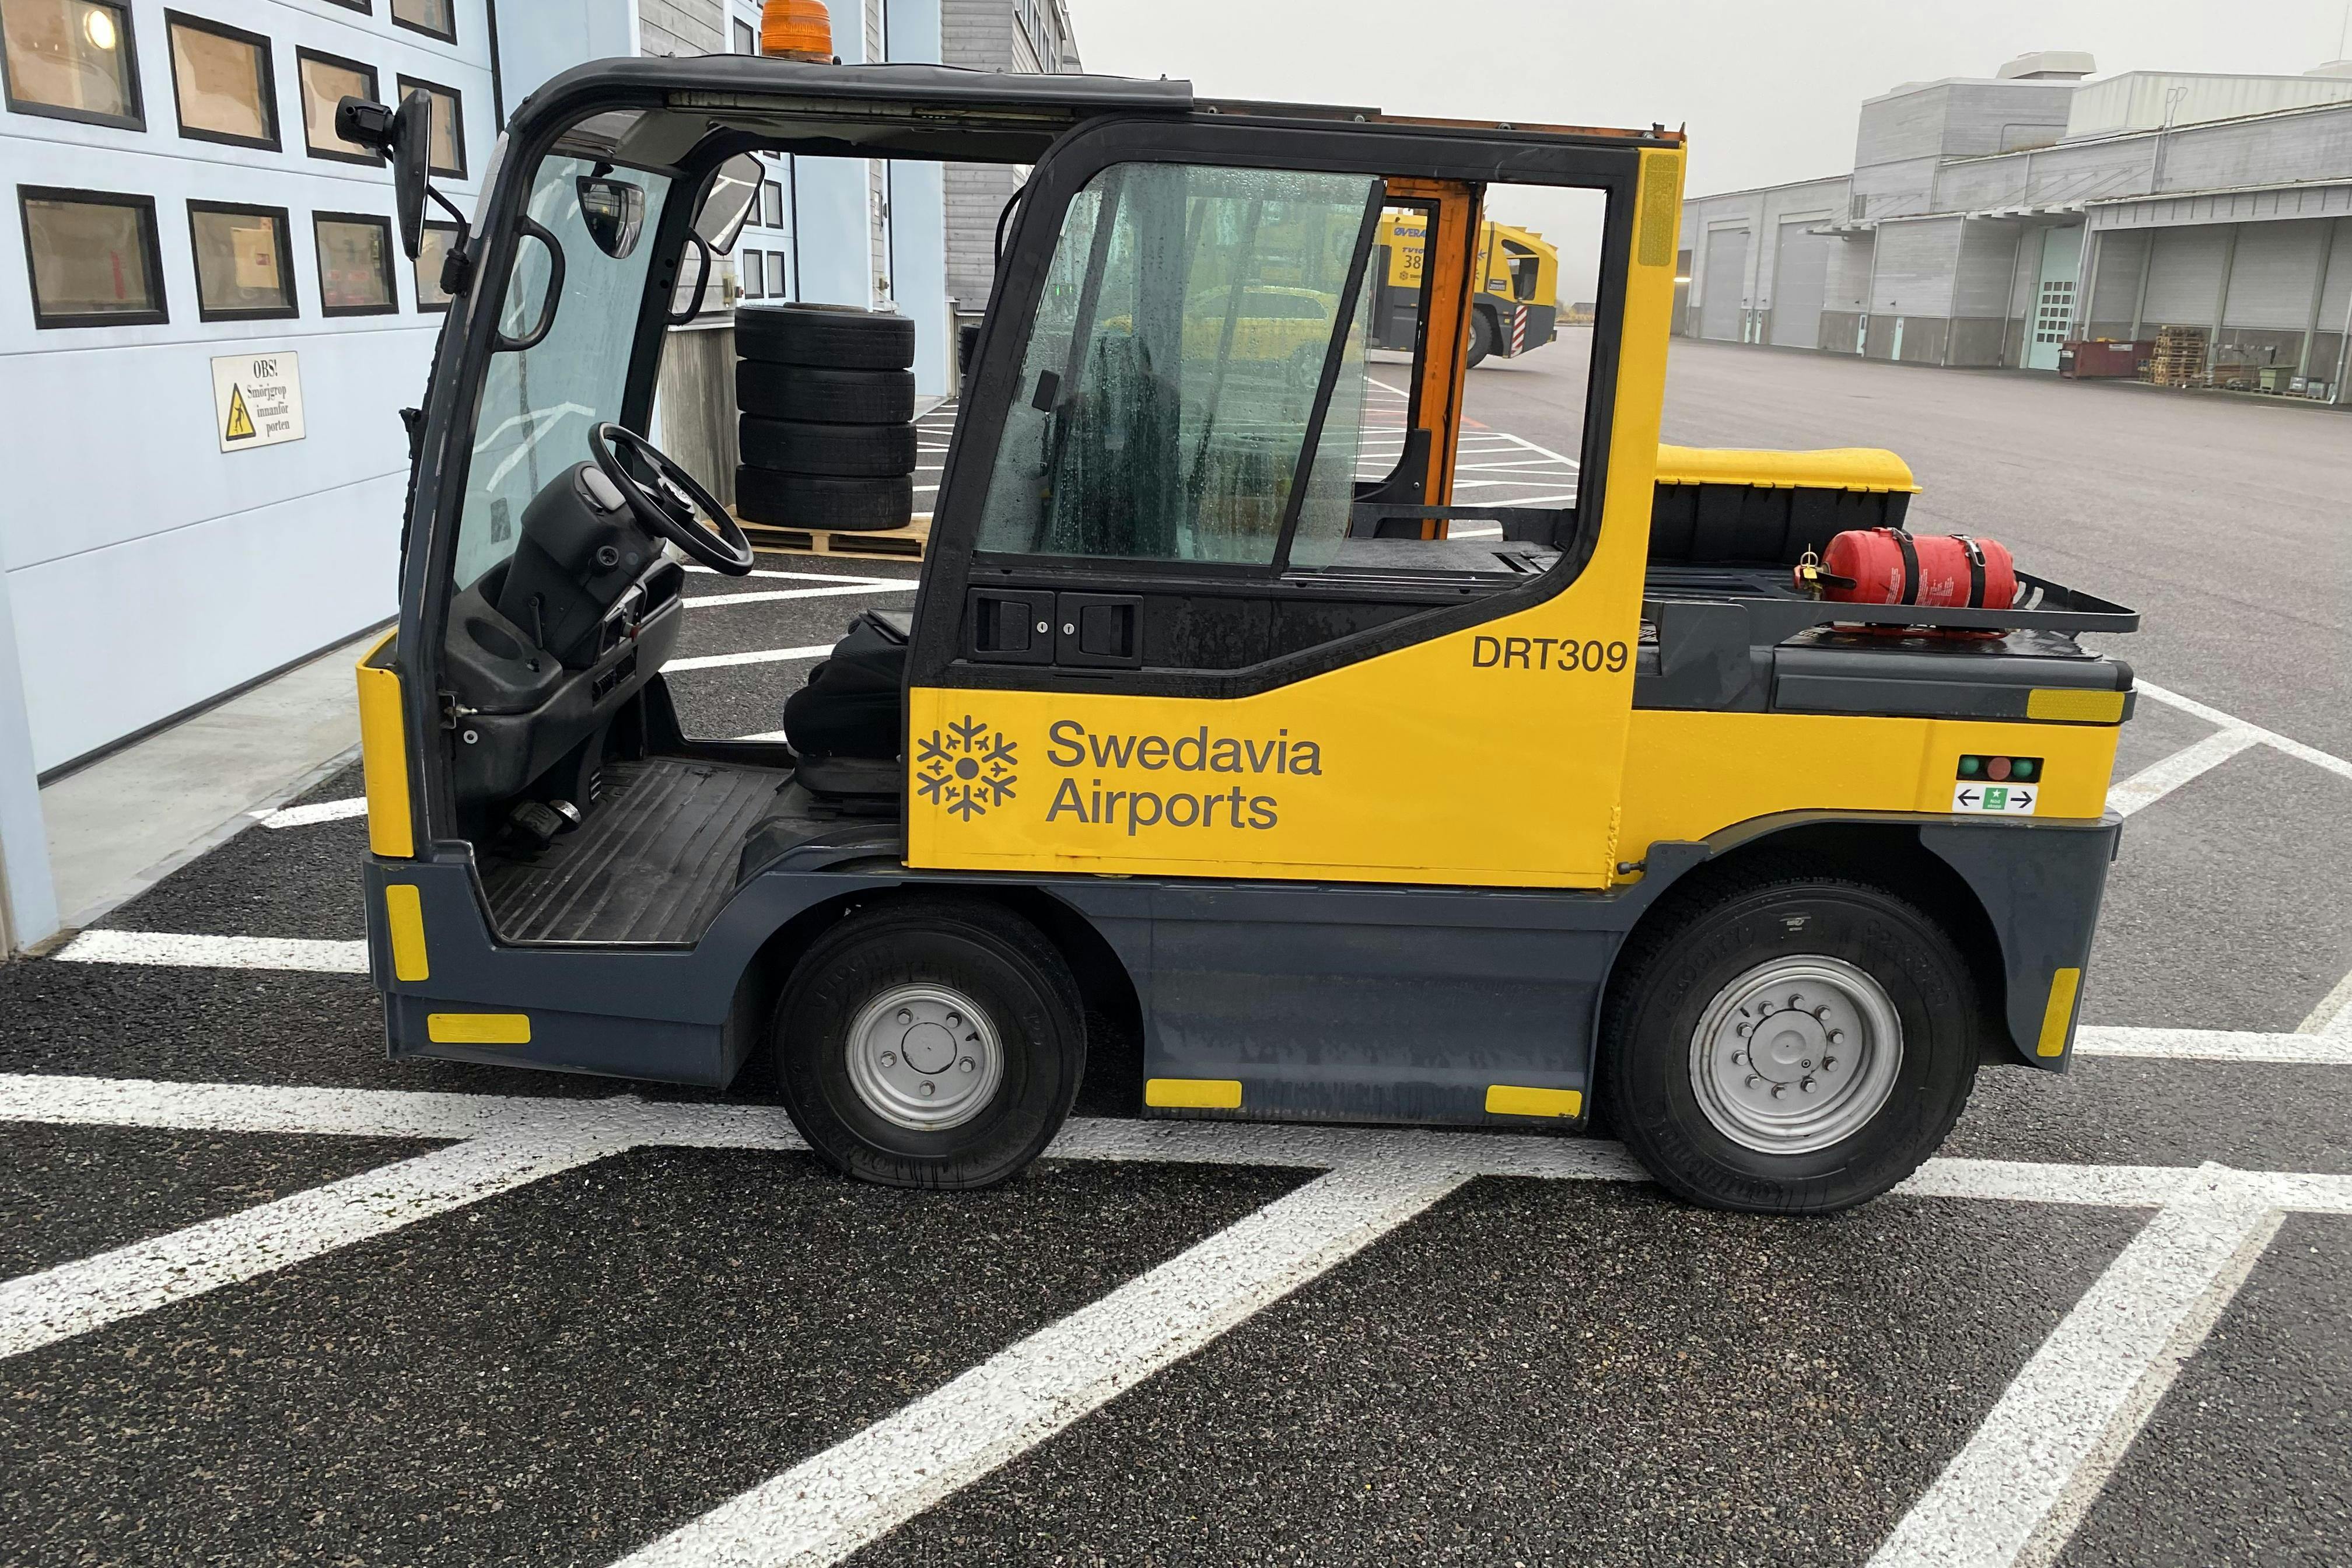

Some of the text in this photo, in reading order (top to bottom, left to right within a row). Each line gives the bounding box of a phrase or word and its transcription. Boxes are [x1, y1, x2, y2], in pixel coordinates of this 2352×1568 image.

[1404, 255, 1421, 269] 38
[253, 359, 278, 378] OBS!
[247, 383, 287, 401] Smörjgrop
[257, 401, 289, 417] innanför
[266, 420, 290, 437] porten
[1472, 636, 1629, 673] DRT309
[1047, 720, 1322, 776] Swedavia
[1045, 778, 1279, 836] Airports
